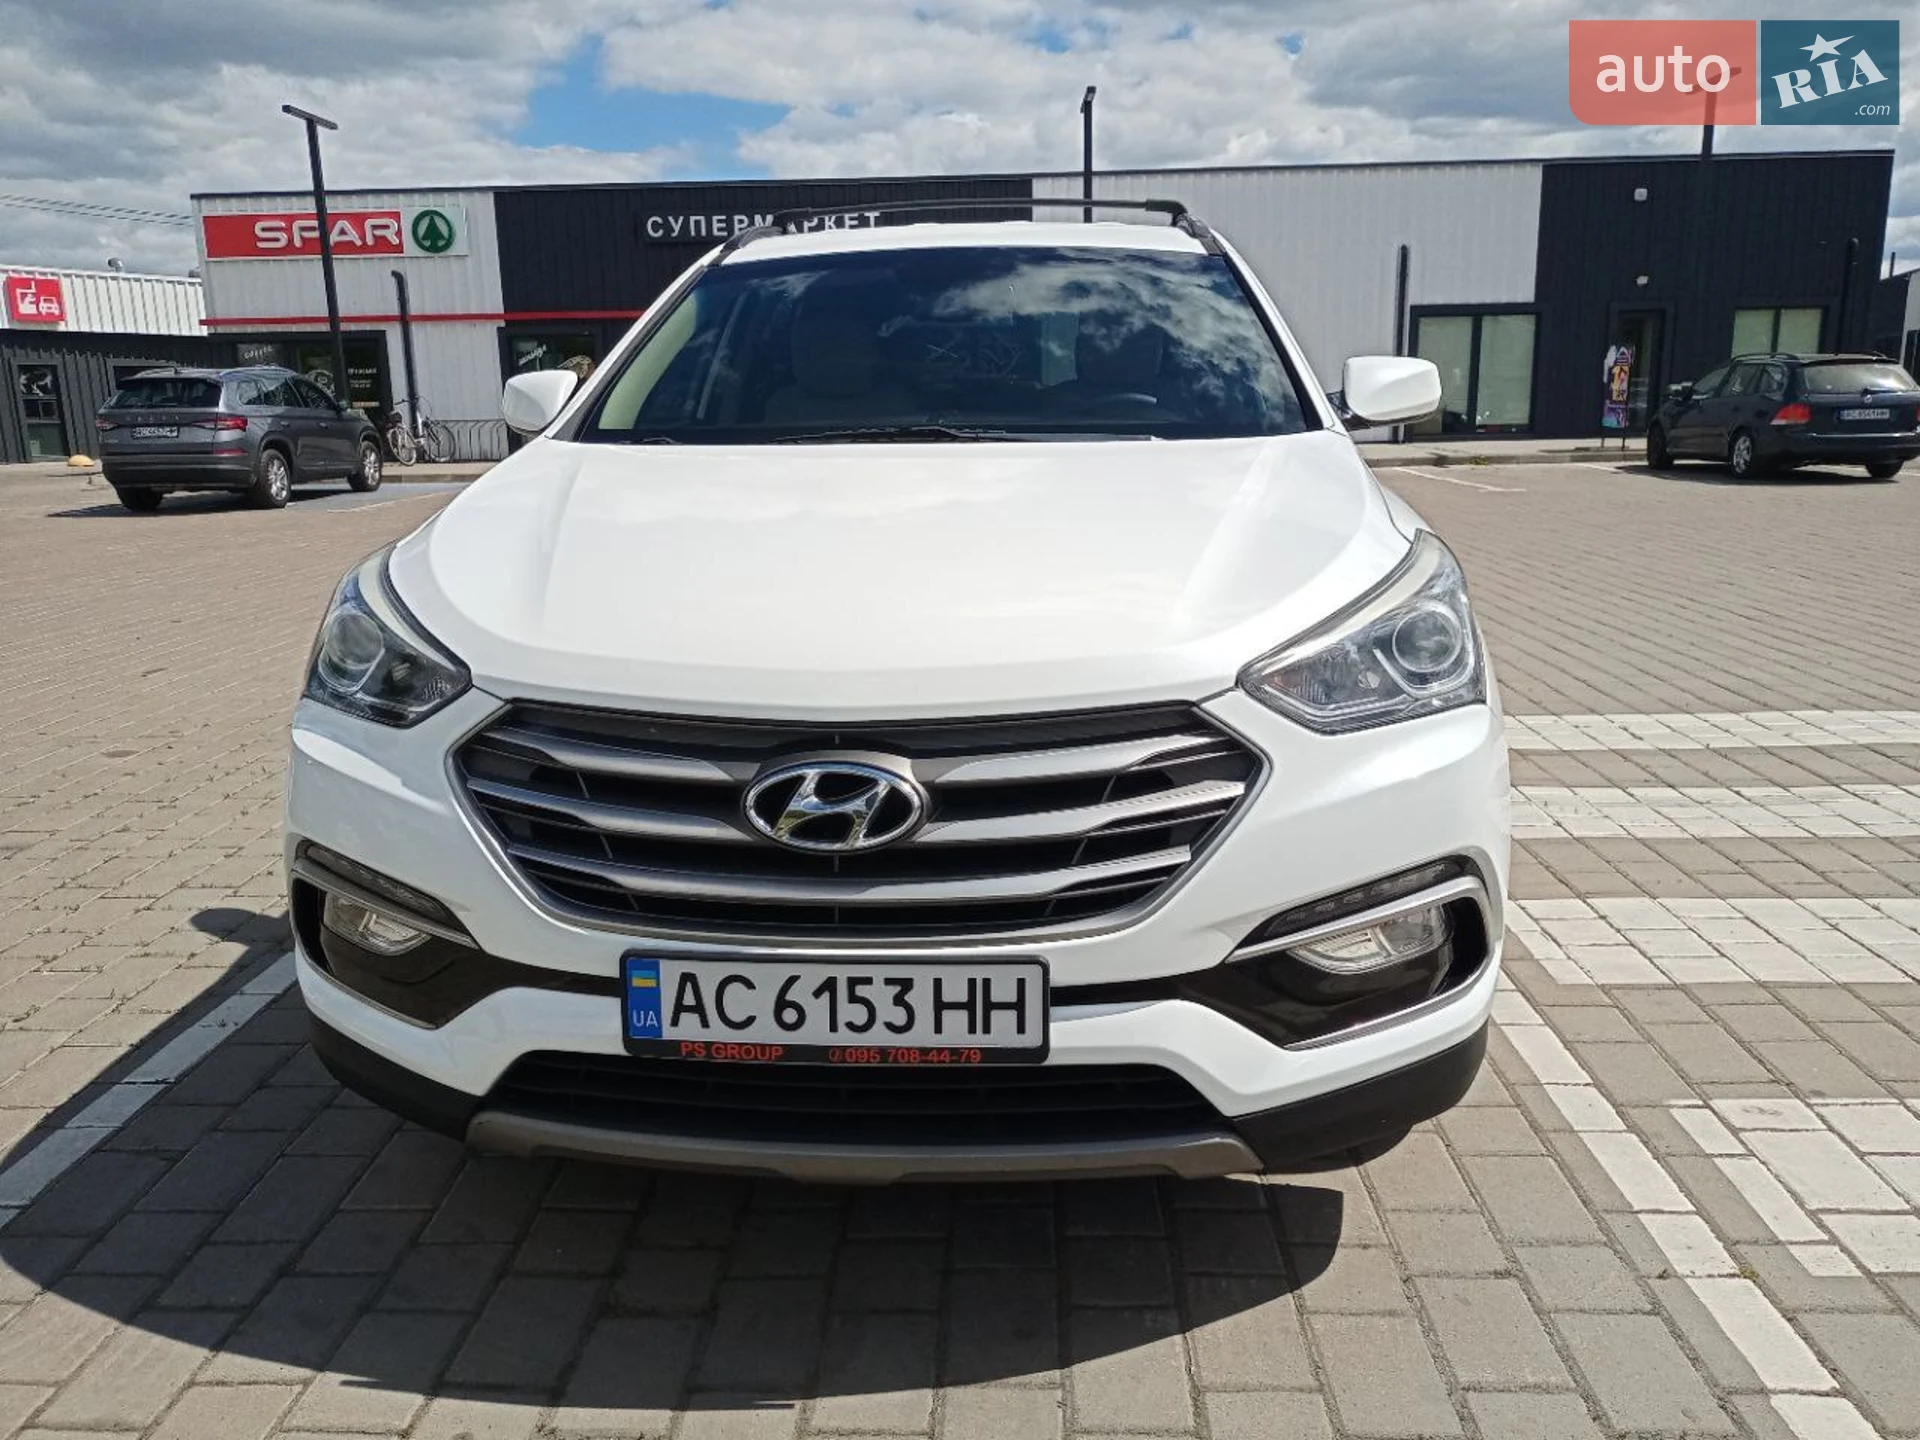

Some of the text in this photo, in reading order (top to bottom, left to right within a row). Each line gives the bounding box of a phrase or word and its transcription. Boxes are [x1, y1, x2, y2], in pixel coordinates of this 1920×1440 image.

[254, 218, 400, 249] SPAR
[669, 972, 1027, 1035] AC 6153 HH
[633, 1010, 659, 1028] UA
[680, 1041, 983, 1064] PS GROUP 095 708-44-79
